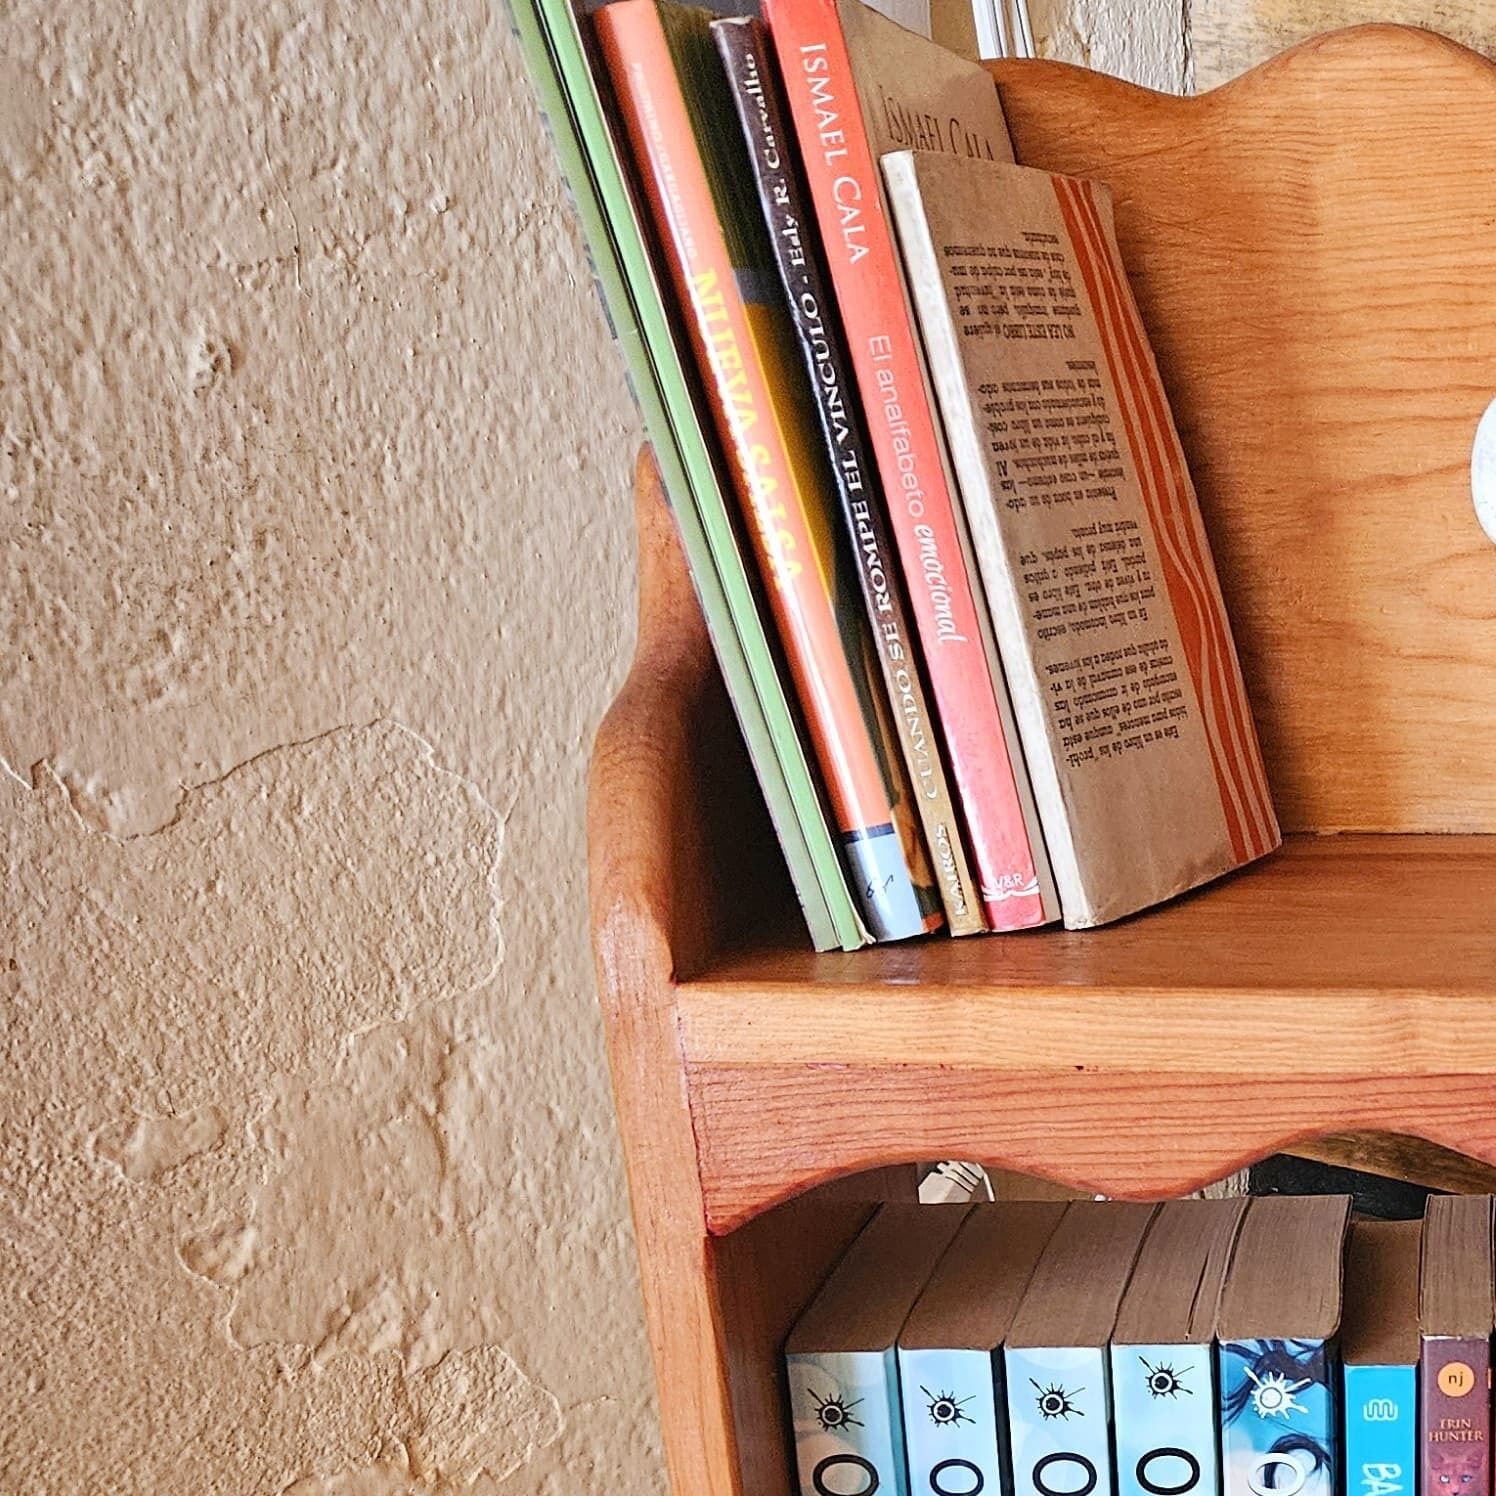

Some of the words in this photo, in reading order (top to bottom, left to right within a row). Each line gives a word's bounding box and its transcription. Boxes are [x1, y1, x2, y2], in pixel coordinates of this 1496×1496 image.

[737, 46, 781, 171] Carvalho
[799, 40, 851, 167] ISMAEL
[830, 173, 875, 264] CALA
[771, 177, 790, 204] R.
[782, 212, 806, 267] Edy
[686, 267, 762, 442] NUEVA
[866, 333, 893, 363] El
[1026, 324, 1048, 338] ESTE
[1046, 324, 1063, 338] LEA
[797, 290, 855, 446] VINCULO
[874, 366, 931, 519] analfabeto
[840, 449, 864, 491] EL
[852, 499, 893, 613] ROMPE
[910, 520, 967, 647] emocional
[881, 622, 904, 661] SE
[893, 668, 939, 800] CUANDO
[1448, 1371, 1465, 1387] nj
[1430, 1430, 1484, 1441] HUNTER
[1441, 1420, 1471, 1429] ERIN
